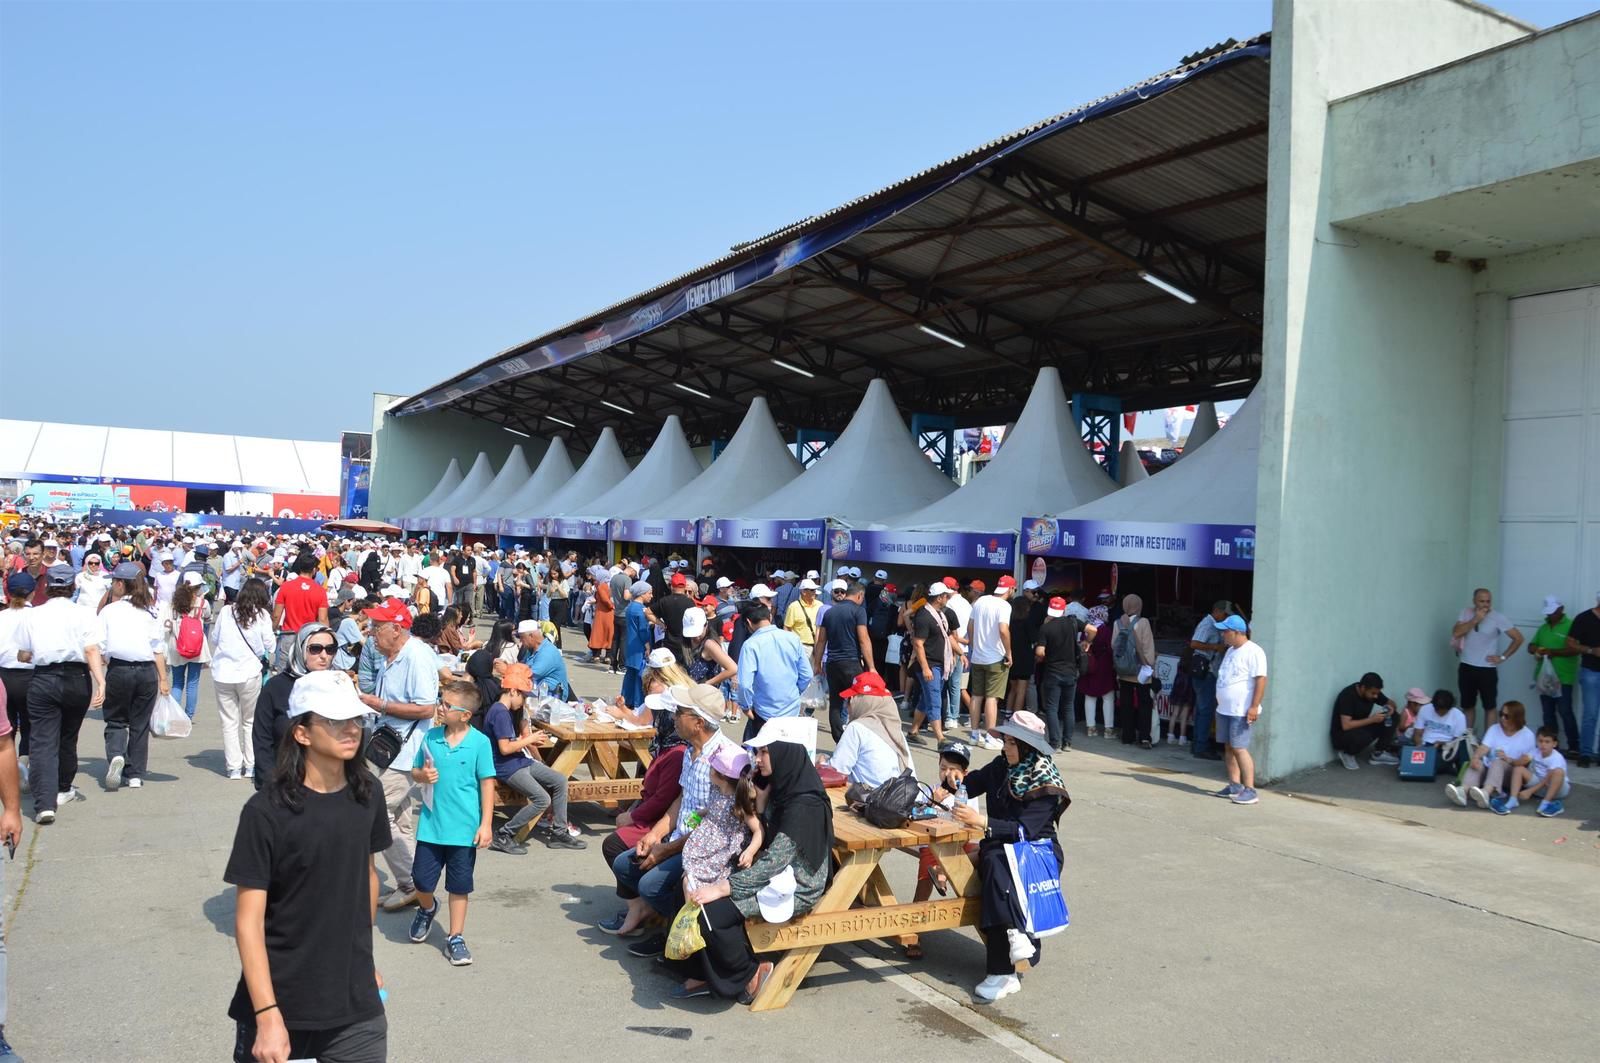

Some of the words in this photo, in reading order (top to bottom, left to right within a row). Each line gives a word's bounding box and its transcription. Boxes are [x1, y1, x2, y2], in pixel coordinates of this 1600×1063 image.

[685, 281, 711, 311] YEMEK
[710, 272, 736, 301] ALANI
[741, 528, 759, 539] NESCAFE
[1063, 531, 1075, 547] A10
[1096, 534, 1119, 547] KORAY
[1146, 536, 1186, 551] RESTORAN
[1214, 538, 1230, 556] A10
[759, 921, 837, 944] SAMSUN
[841, 905, 948, 933] BÜYÜKŞEHİR
